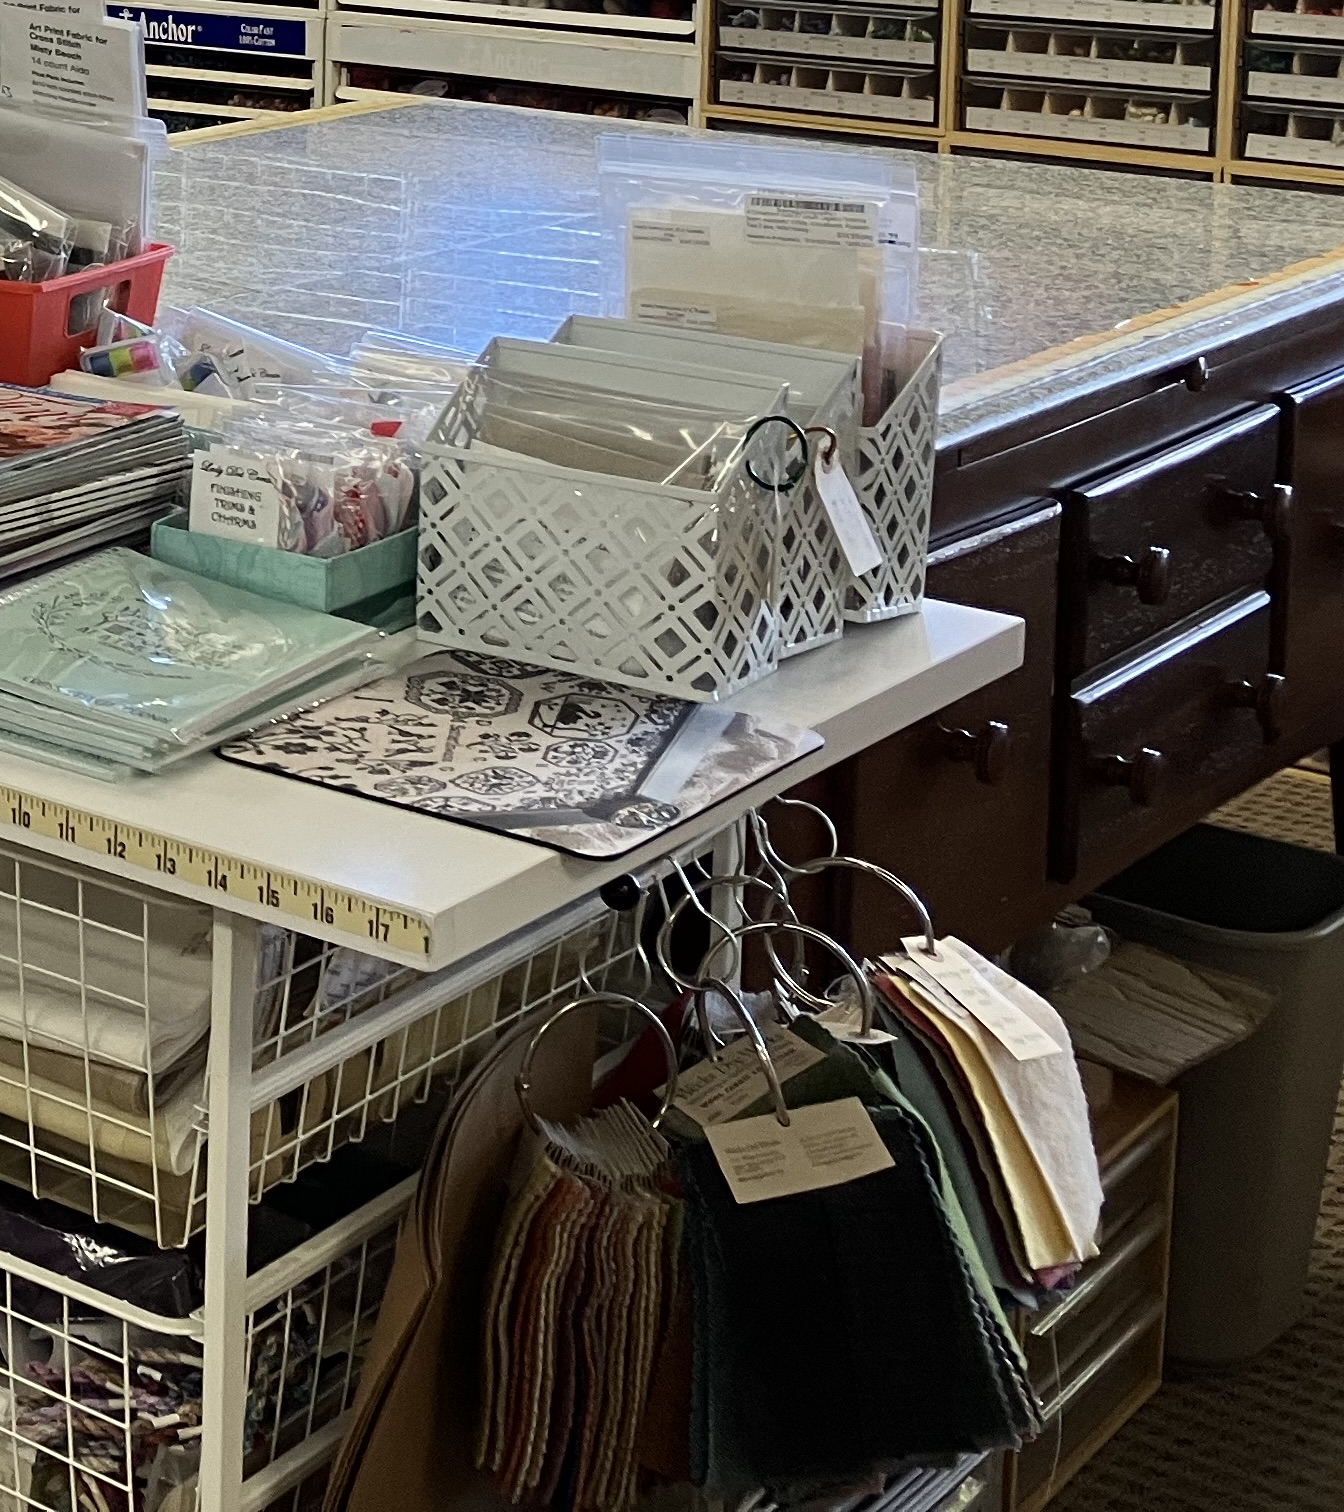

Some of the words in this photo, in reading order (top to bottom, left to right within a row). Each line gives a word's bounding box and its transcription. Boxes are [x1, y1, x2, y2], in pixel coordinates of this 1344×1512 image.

[66, 29, 93, 43] Fabric
[140, 11, 196, 43] Anchor
[248, 504, 256, 516] &
[11, 807, 31, 829] 10
[58, 822, 77, 844] 11
[106, 837, 126, 859] 12
[155, 853, 177, 876] 13
[206, 868, 228, 892] 14
[257, 884, 280, 908] 15
[311, 900, 335, 924] 16
[367, 918, 390, 943] 17
